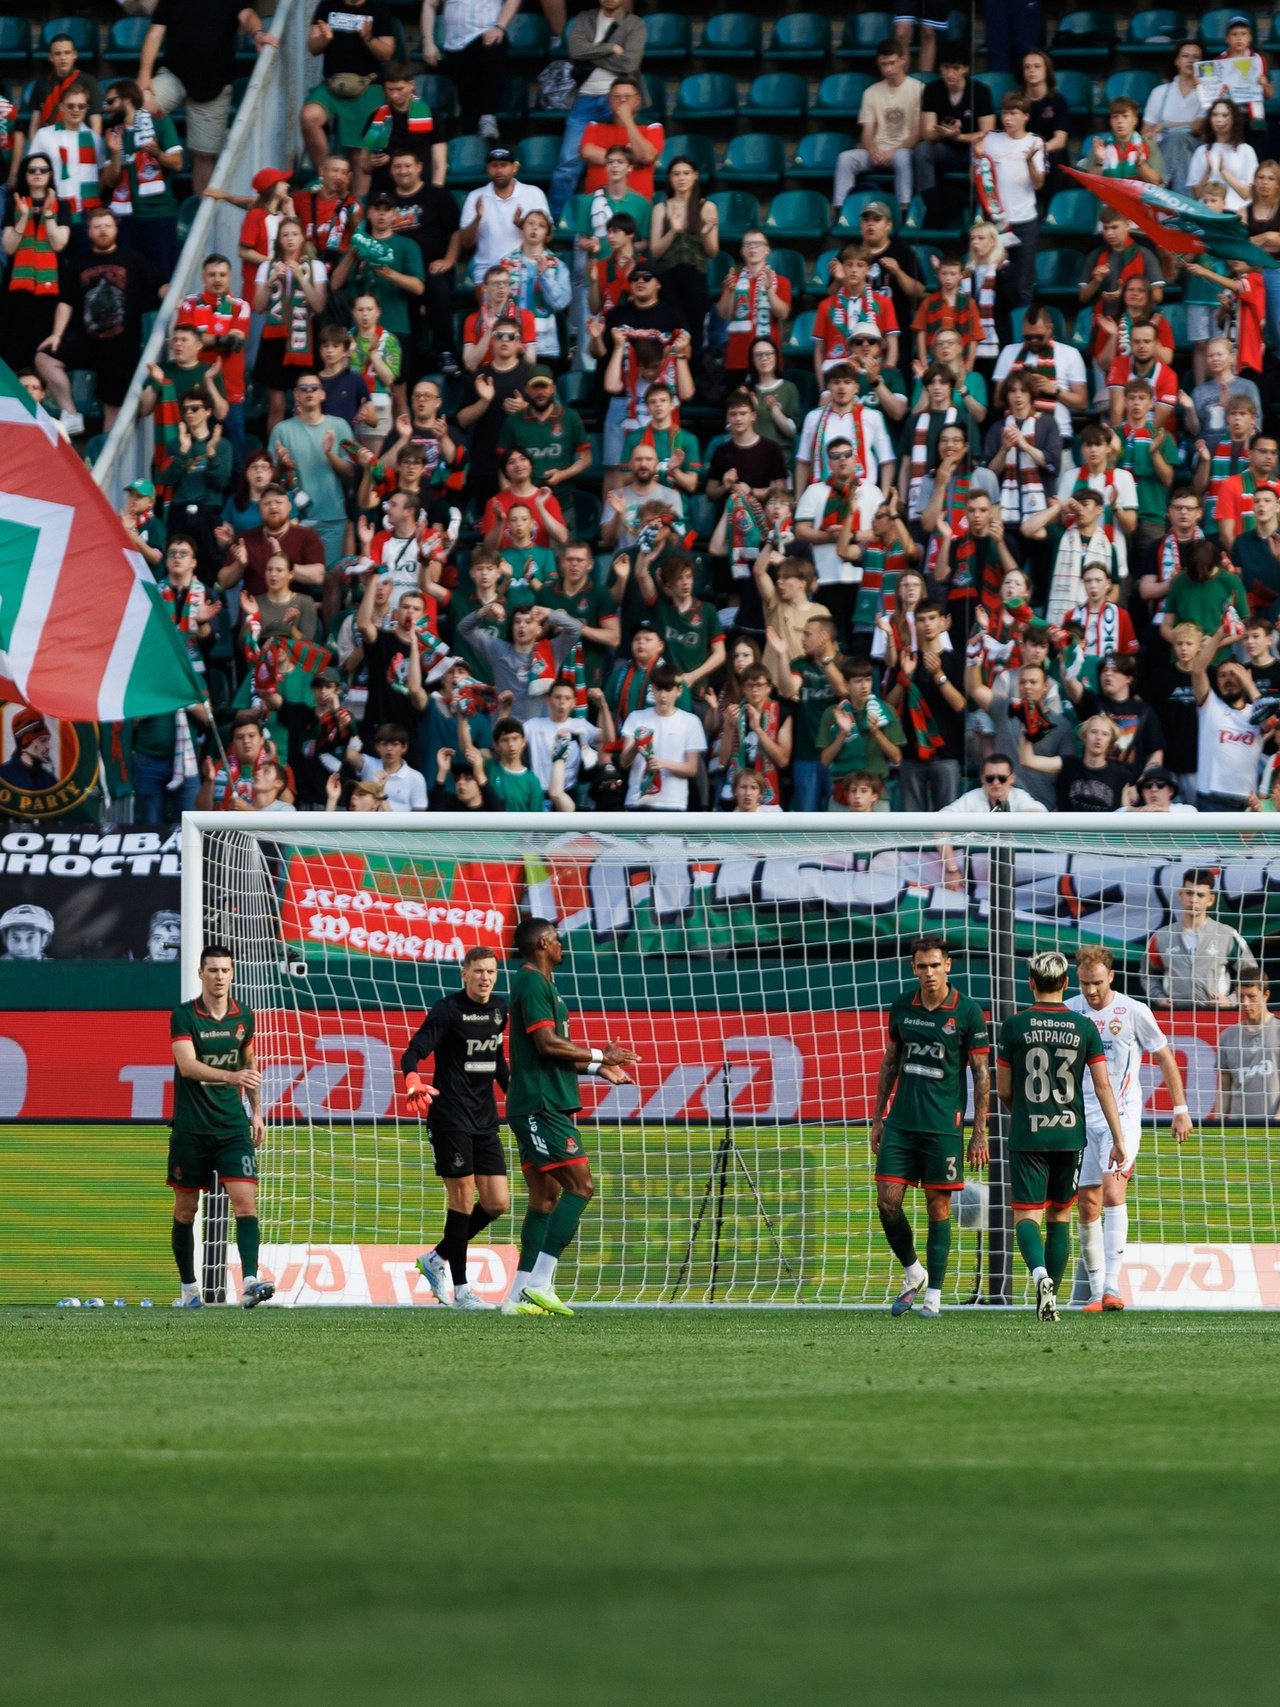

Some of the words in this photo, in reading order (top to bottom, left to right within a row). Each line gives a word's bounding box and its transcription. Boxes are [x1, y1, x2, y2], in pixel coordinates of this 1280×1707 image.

[19, 780, 82, 811] PARTY
[299, 888, 506, 934] Red-Green
[308, 913, 466, 961] Weekend
[200, 1030, 231, 1039] BetBoom
[903, 1017, 935, 1028] BetBoom
[1030, 1018, 1075, 1029] BetBoom
[1023, 1030, 1080, 1048] БАТРАКОВ
[1025, 1047, 1078, 1104] 83
[945, 1156, 957, 1181] 3
